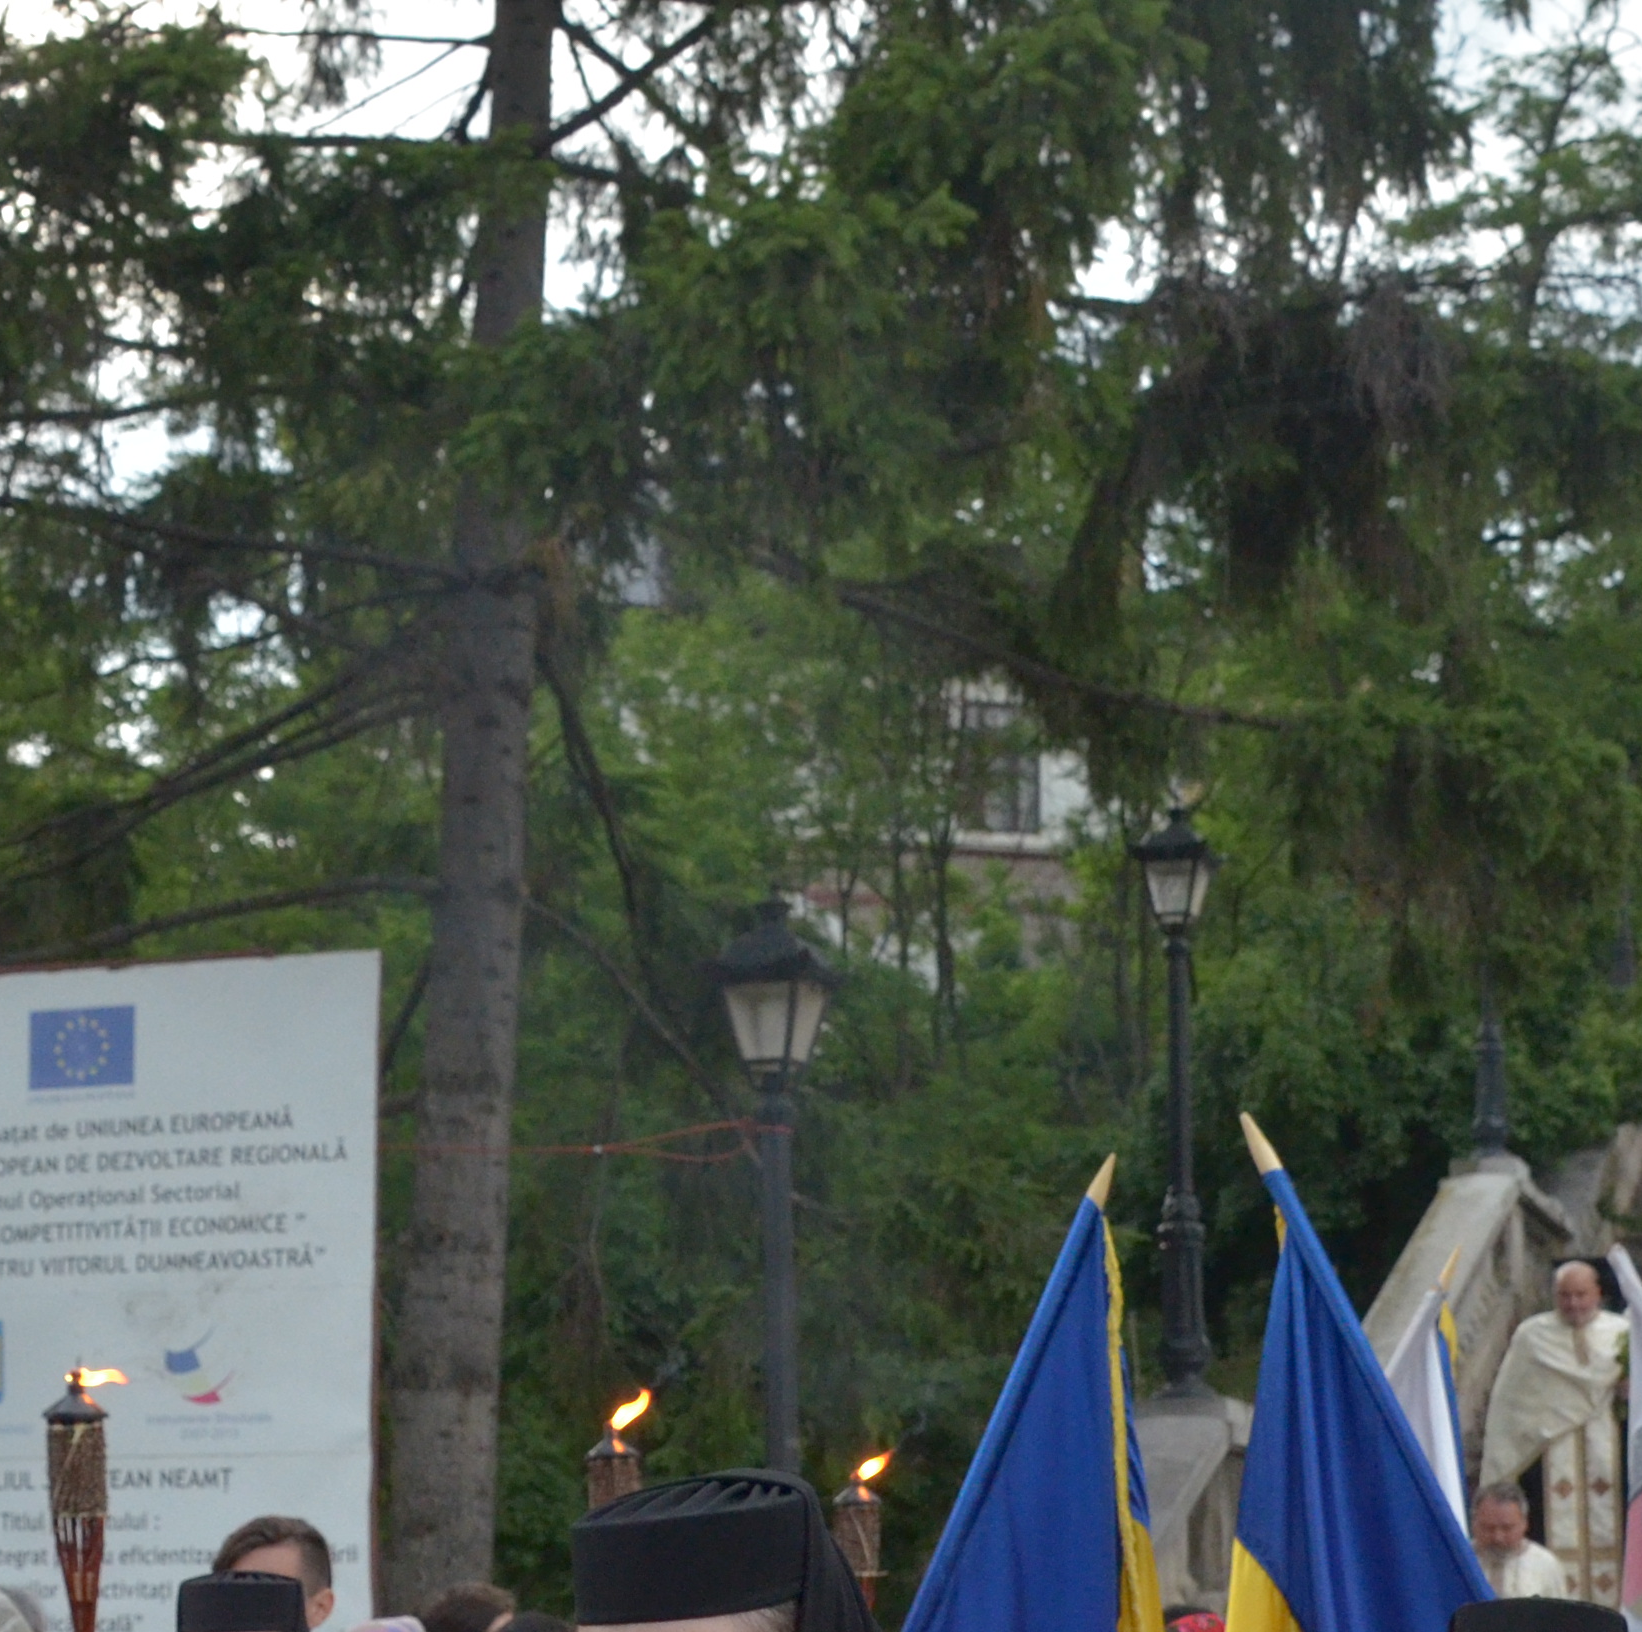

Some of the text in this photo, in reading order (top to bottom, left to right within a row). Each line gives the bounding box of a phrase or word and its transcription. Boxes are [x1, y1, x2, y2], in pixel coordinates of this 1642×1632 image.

[45, 1122, 69, 1141] de
[76, 1115, 164, 1139] UNIUNEA
[170, 1104, 294, 1134] EUROPEANĂ
[65, 1153, 91, 1174] DE
[96, 1146, 224, 1173] DEZVOLTARE
[230, 1136, 348, 1167] REGIONALĂ
[151, 1181, 241, 1205] Sectorial
[168, 1212, 288, 1238] ECONOMICE
[40, 1252, 129, 1278] VIITORUL
[159, 1467, 233, 1493] NEAMȚ
[0, 1511, 46, 1532] Titlul
